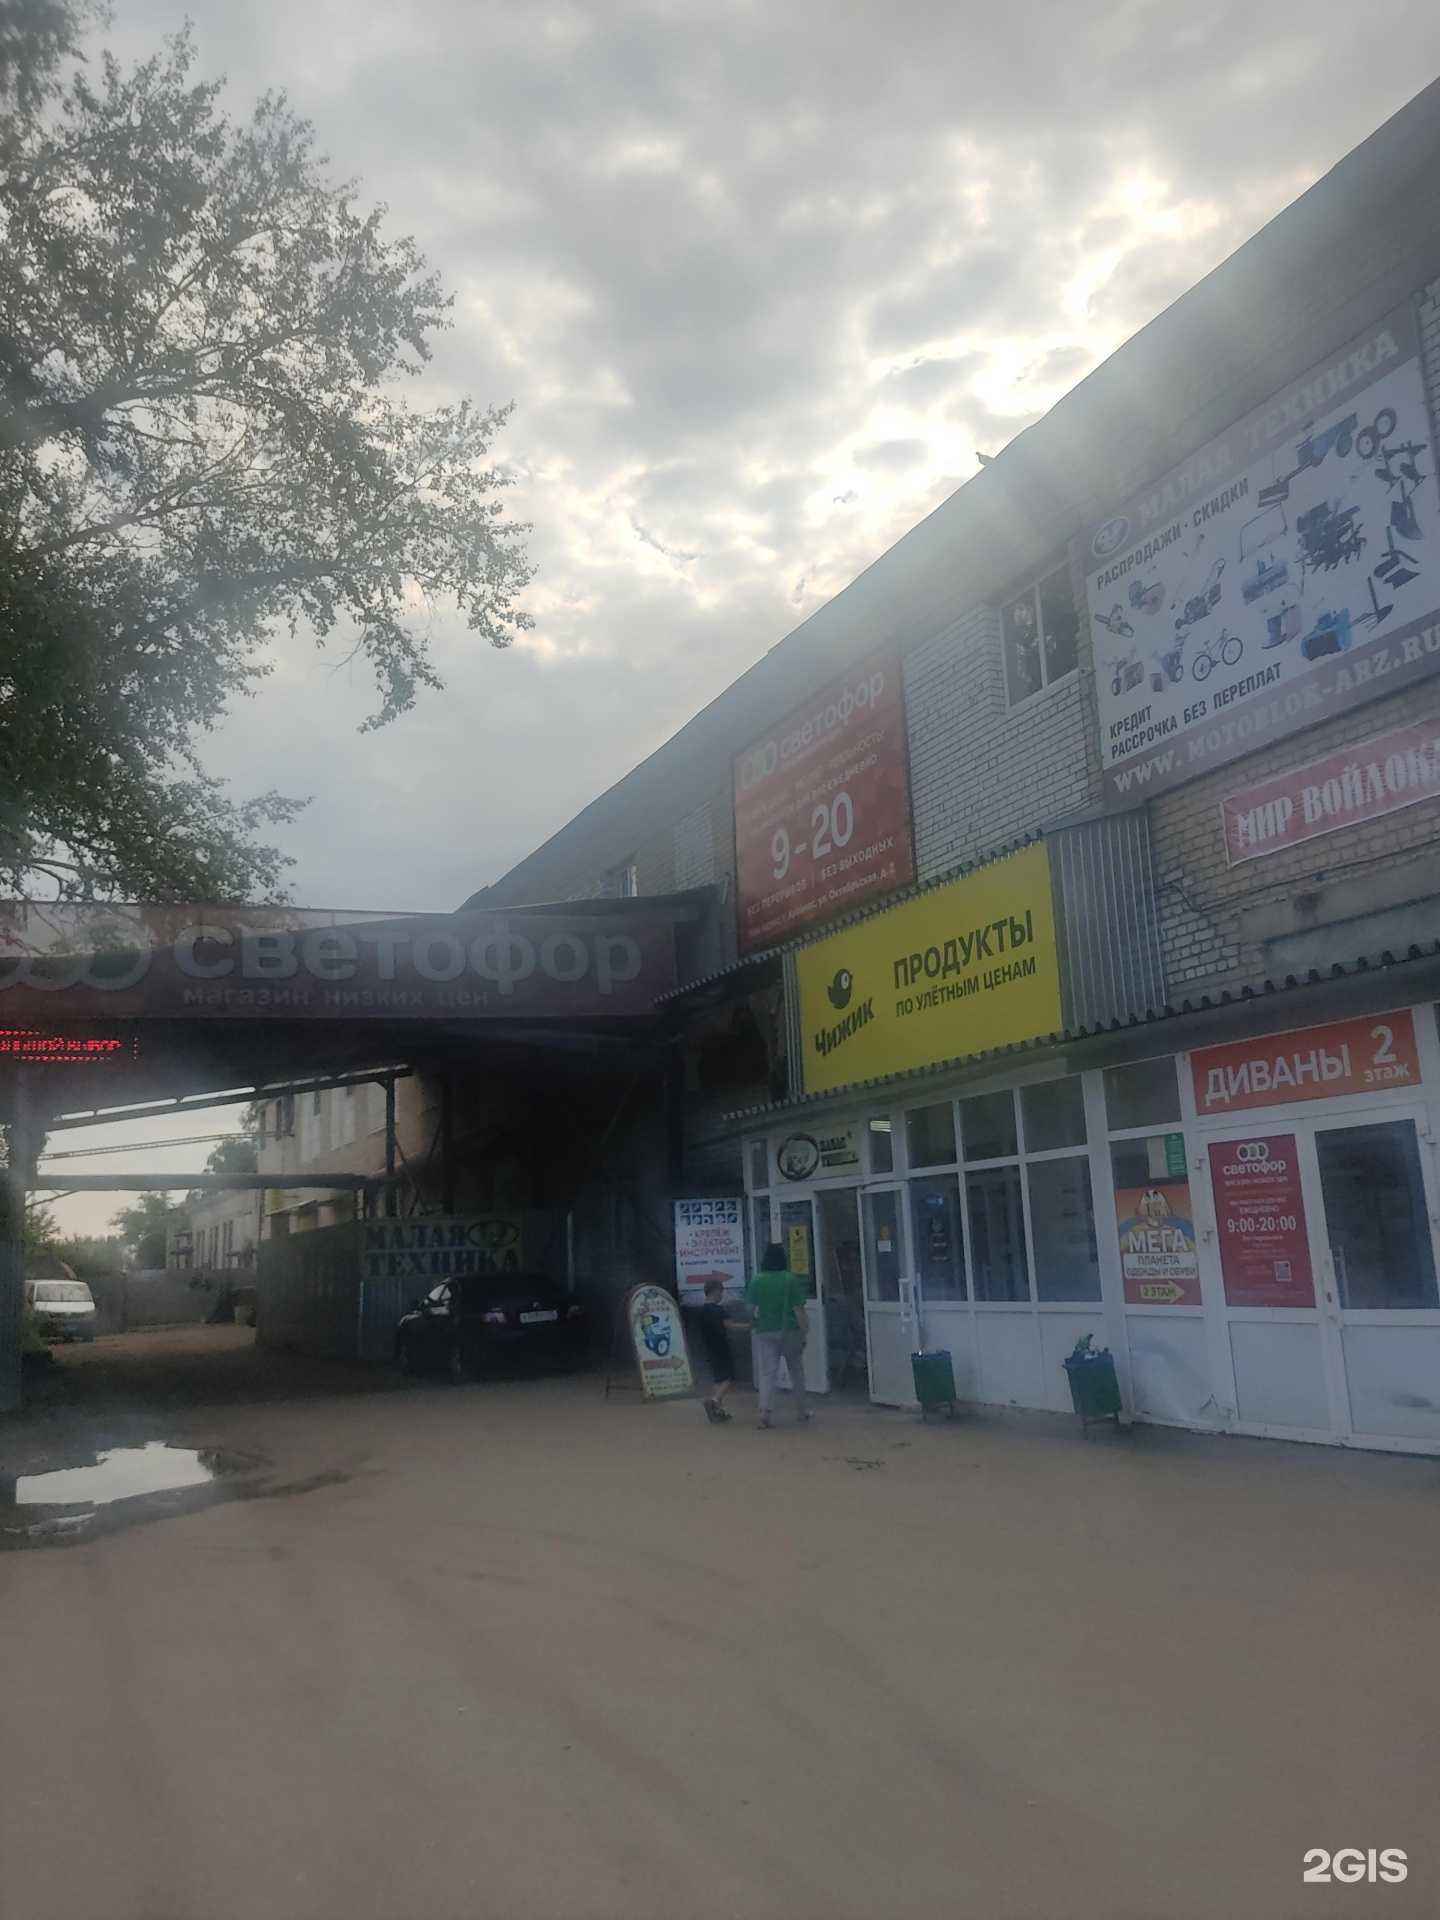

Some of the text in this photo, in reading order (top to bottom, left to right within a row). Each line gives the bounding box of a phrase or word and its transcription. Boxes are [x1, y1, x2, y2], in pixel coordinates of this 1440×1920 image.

[1097, 478, 1249, 591] РАСПРОДАЖИ СКИДКИ
[780, 671, 885, 760] светофор
[1110, 705, 1152, 739] КРЕДИТ
[1111, 662, 1282, 759] РАССРОЧКА БЕЗ ПЕРЕПЛАТ
[174, 918, 642, 995] светофор
[893, 910, 1034, 989] ПРОДУКТЫ
[184, 987, 489, 1009] магазин низких цен
[895, 956, 1036, 1018] ПО УЛЁТНЫМ ЦЕНАМ
[815, 997, 875, 1056] ЧИЖИК
[1369, 1024, 1397, 1066] 2
[1204, 1043, 1353, 1105] ДИВАНЫ
[1364, 1064, 1411, 1085] этаж
[1222, 1158, 1287, 1177] светофор
[1128, 1229, 1188, 1253] МЕГА
[1226, 1215, 1297, 1233] 9:00-20:00
[367, 1248, 520, 1276] ТЕХНИКА
[1137, 1254, 1180, 1266] ПЛАНЕТА
